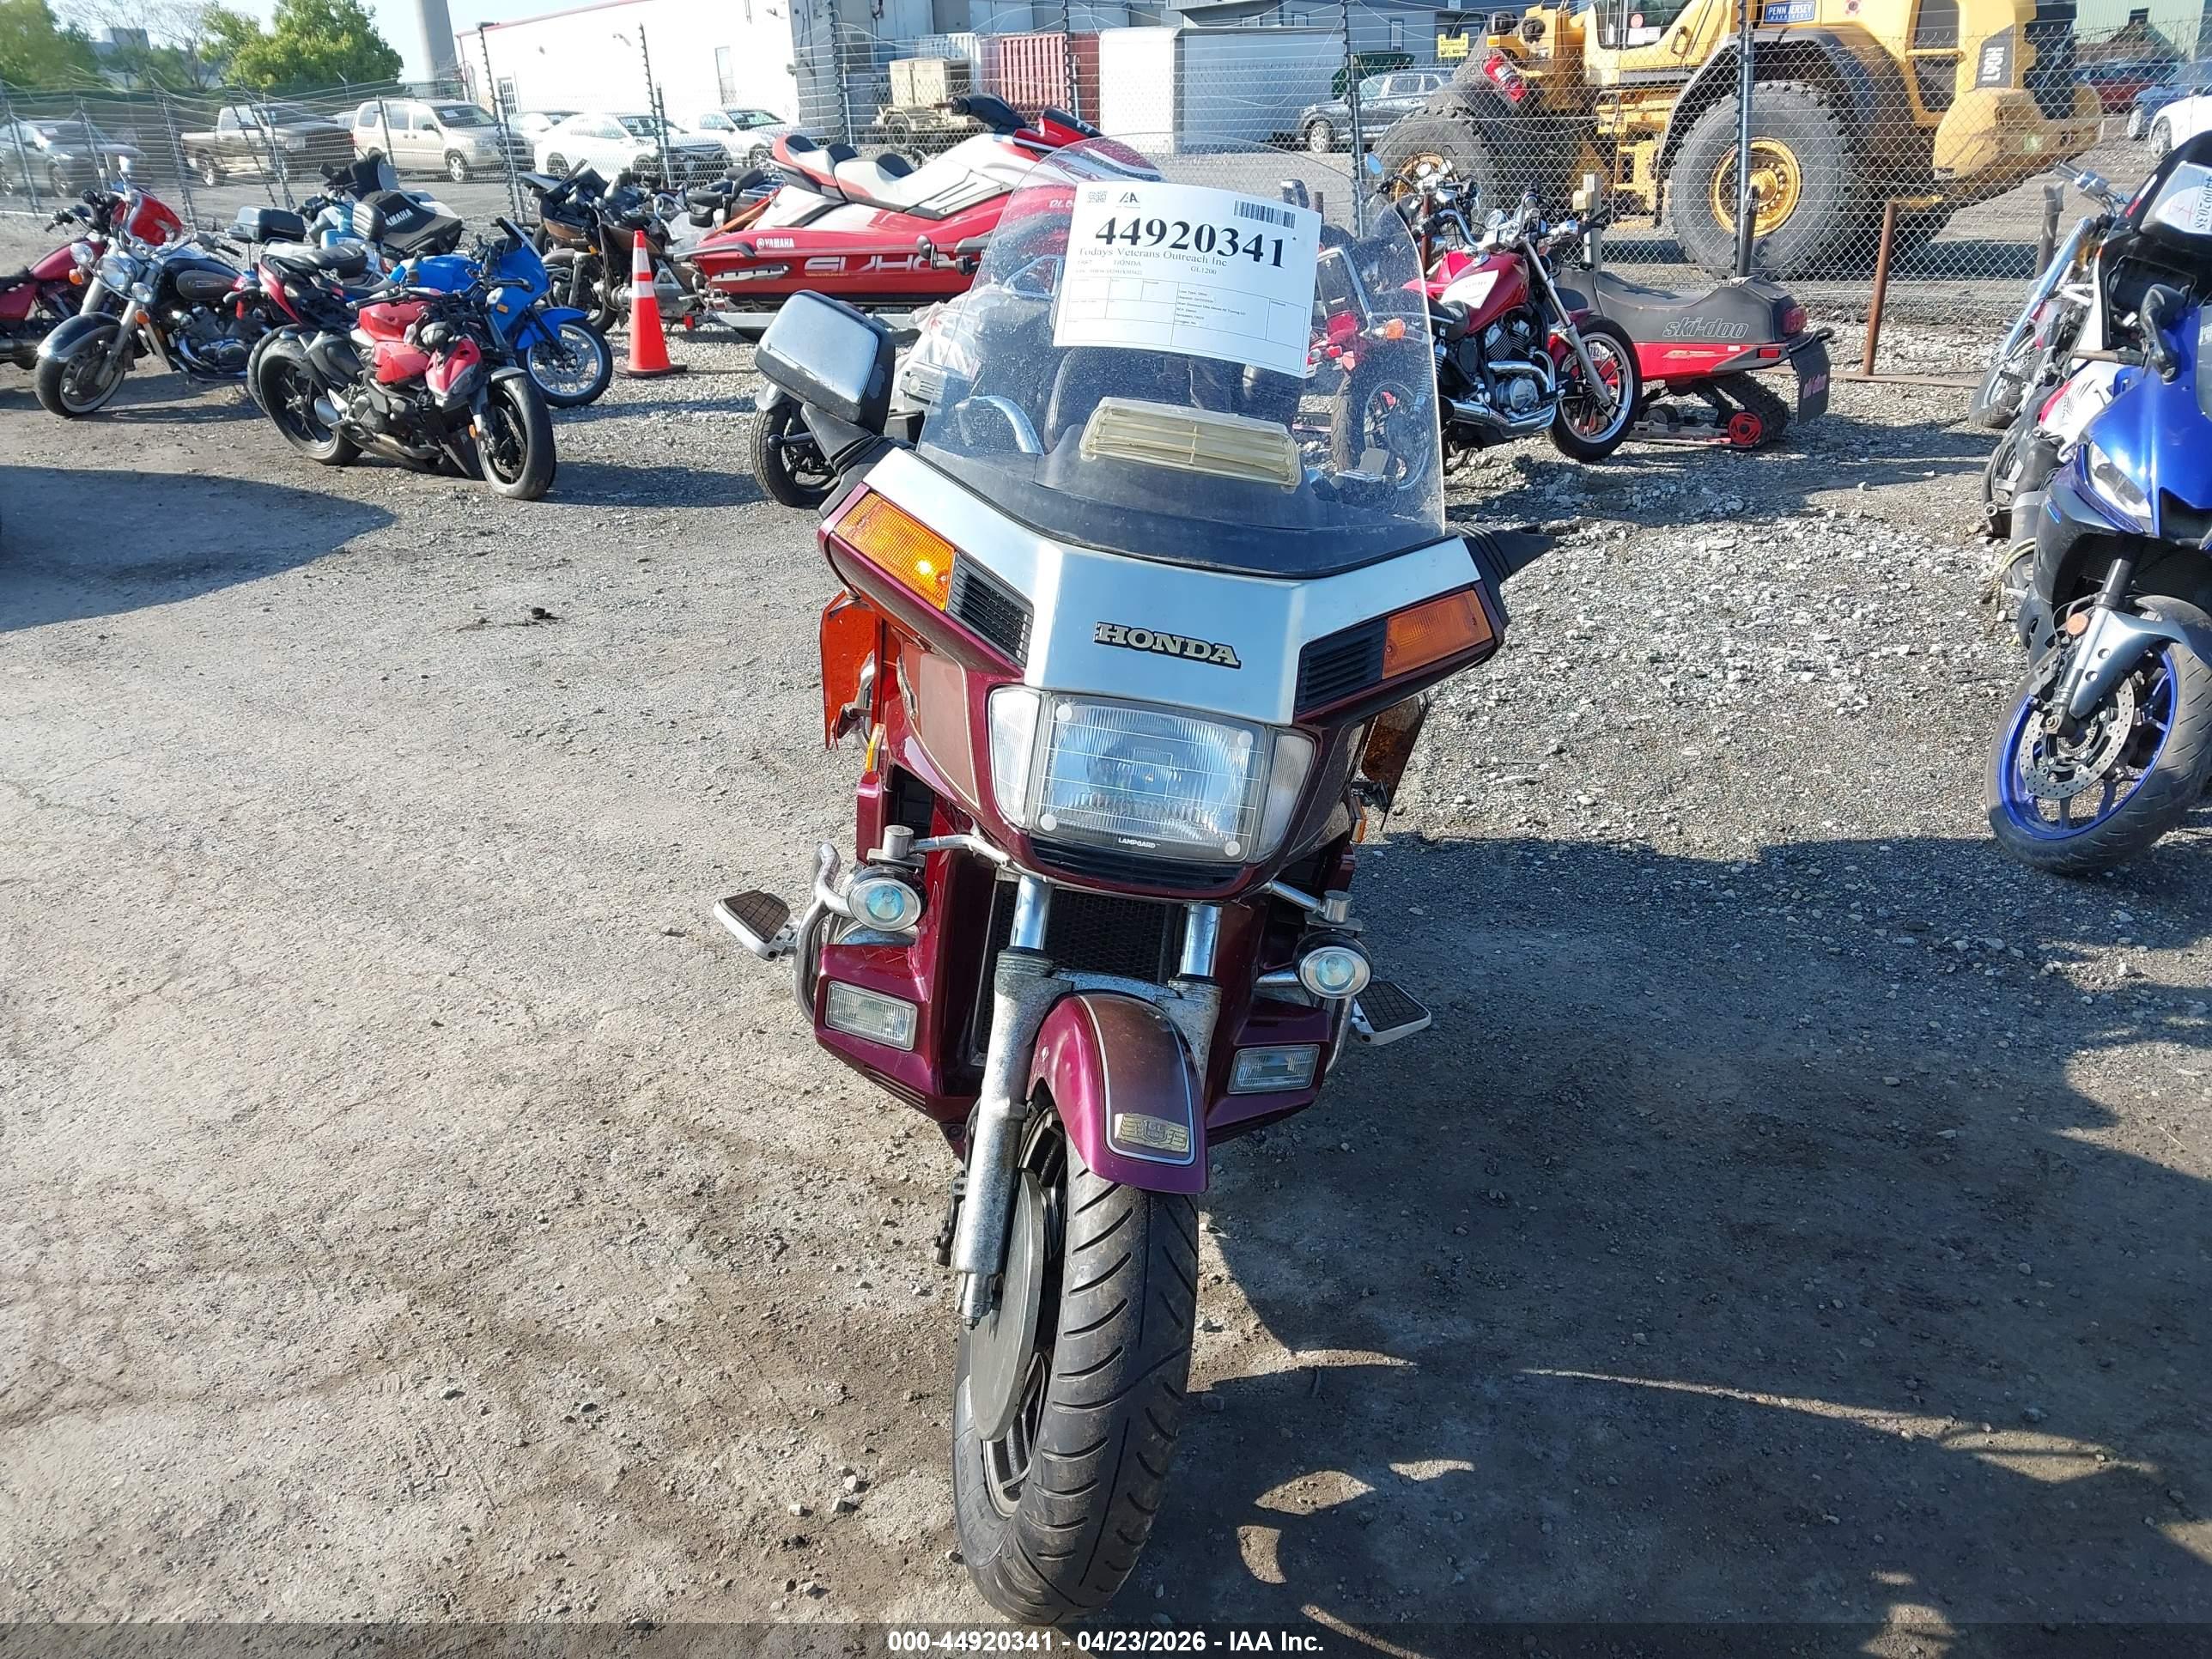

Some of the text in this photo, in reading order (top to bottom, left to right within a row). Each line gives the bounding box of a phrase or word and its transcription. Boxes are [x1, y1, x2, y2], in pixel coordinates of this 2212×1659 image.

[1769, 3, 1813, 15] PENN JERSEY
[385, 208, 413, 227] AMAHA
[765, 238, 795, 248] YAMAHA
[1095, 217, 1285, 270] 44920341
[1079, 247, 1227, 267] Todays Veterans Outreach Inc
[1190, 266, 1217, 275] GL1200
[1662, 317, 1749, 338] ski-doo
[1094, 622, 1242, 670] HONDA
